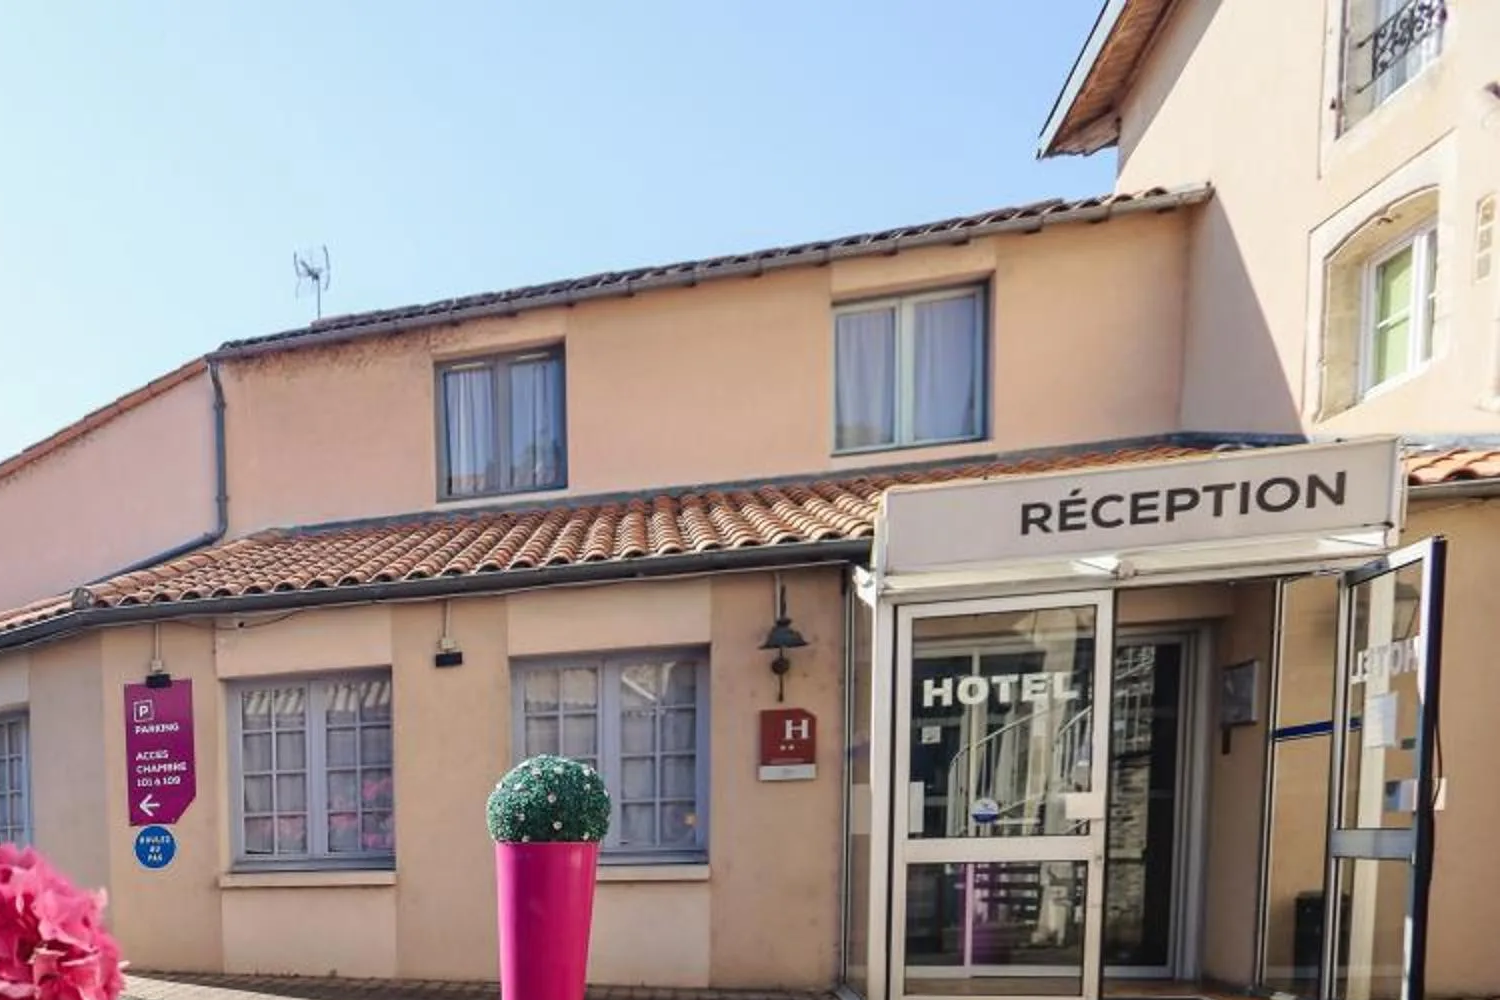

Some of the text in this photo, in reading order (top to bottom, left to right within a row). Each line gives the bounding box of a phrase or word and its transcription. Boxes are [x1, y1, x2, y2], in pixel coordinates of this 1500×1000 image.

[1020, 471, 1347, 536] RÉCEPTION
[923, 672, 1079, 707] HOTEL
[139, 705, 149, 718] P
[135, 722, 179, 734] PARKING
[784, 719, 809, 740] H
[137, 778, 153, 787] 101
